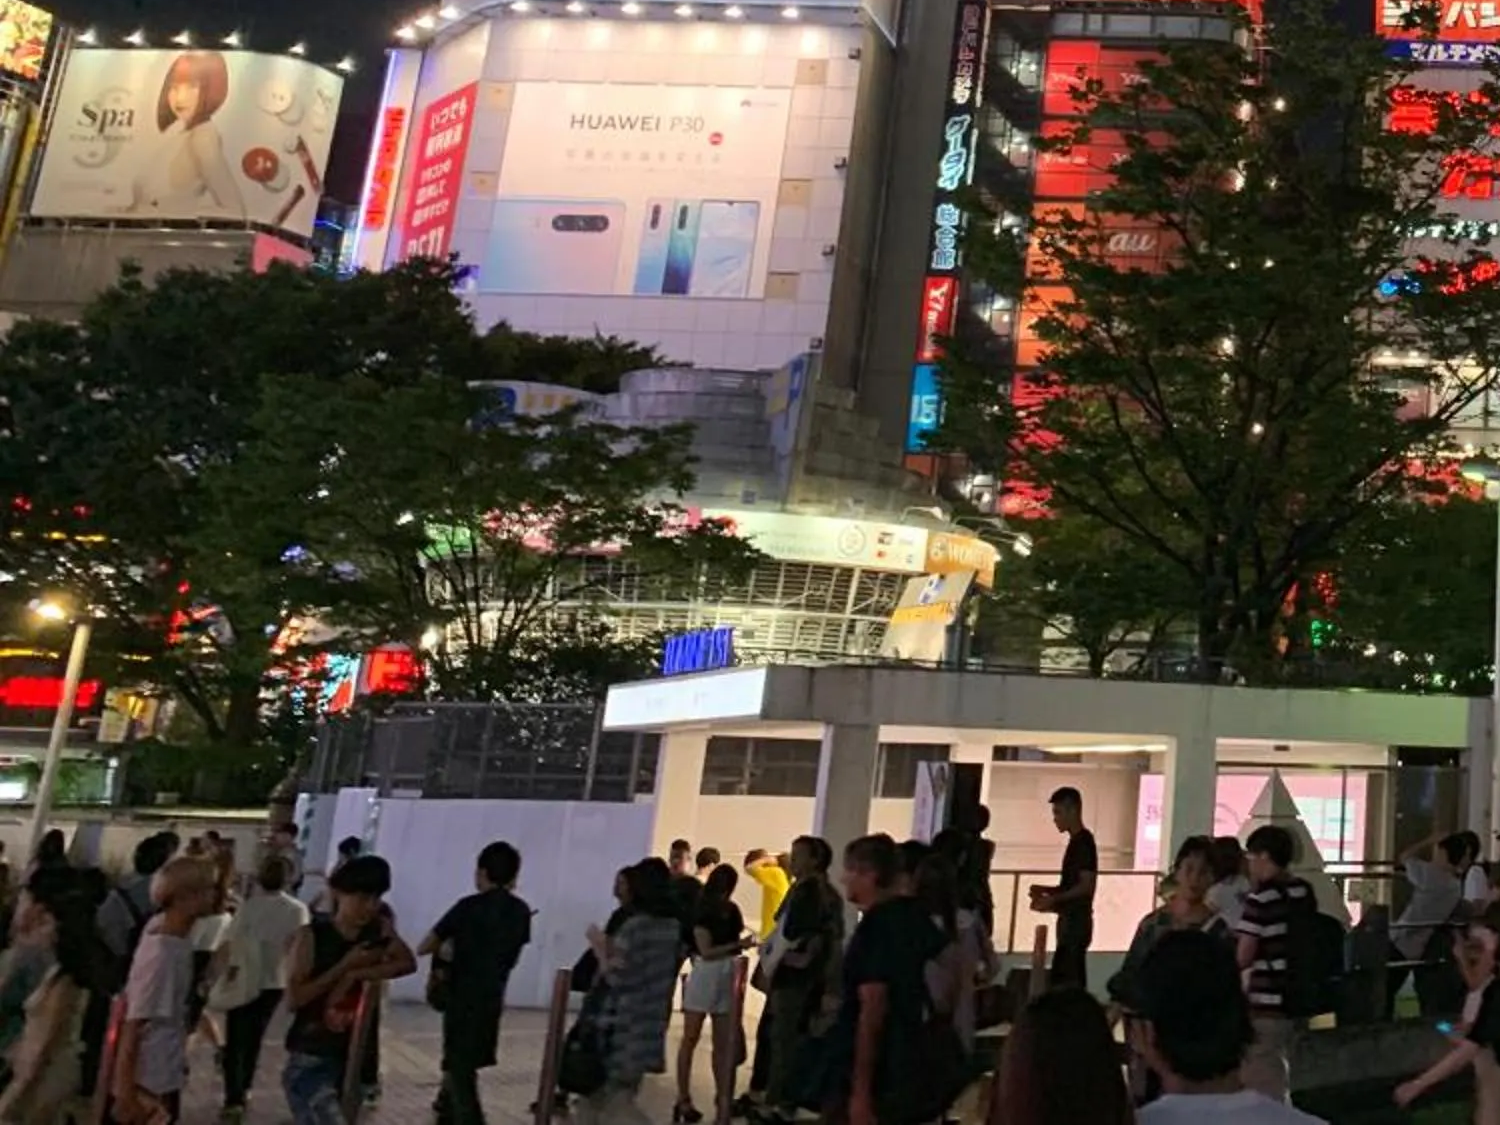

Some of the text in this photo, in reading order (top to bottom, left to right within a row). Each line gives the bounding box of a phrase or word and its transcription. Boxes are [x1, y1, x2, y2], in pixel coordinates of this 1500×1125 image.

[76, 102, 134, 135] Spa
[570, 113, 706, 133] HUAWEI P30
[1108, 231, 1157, 253] au
